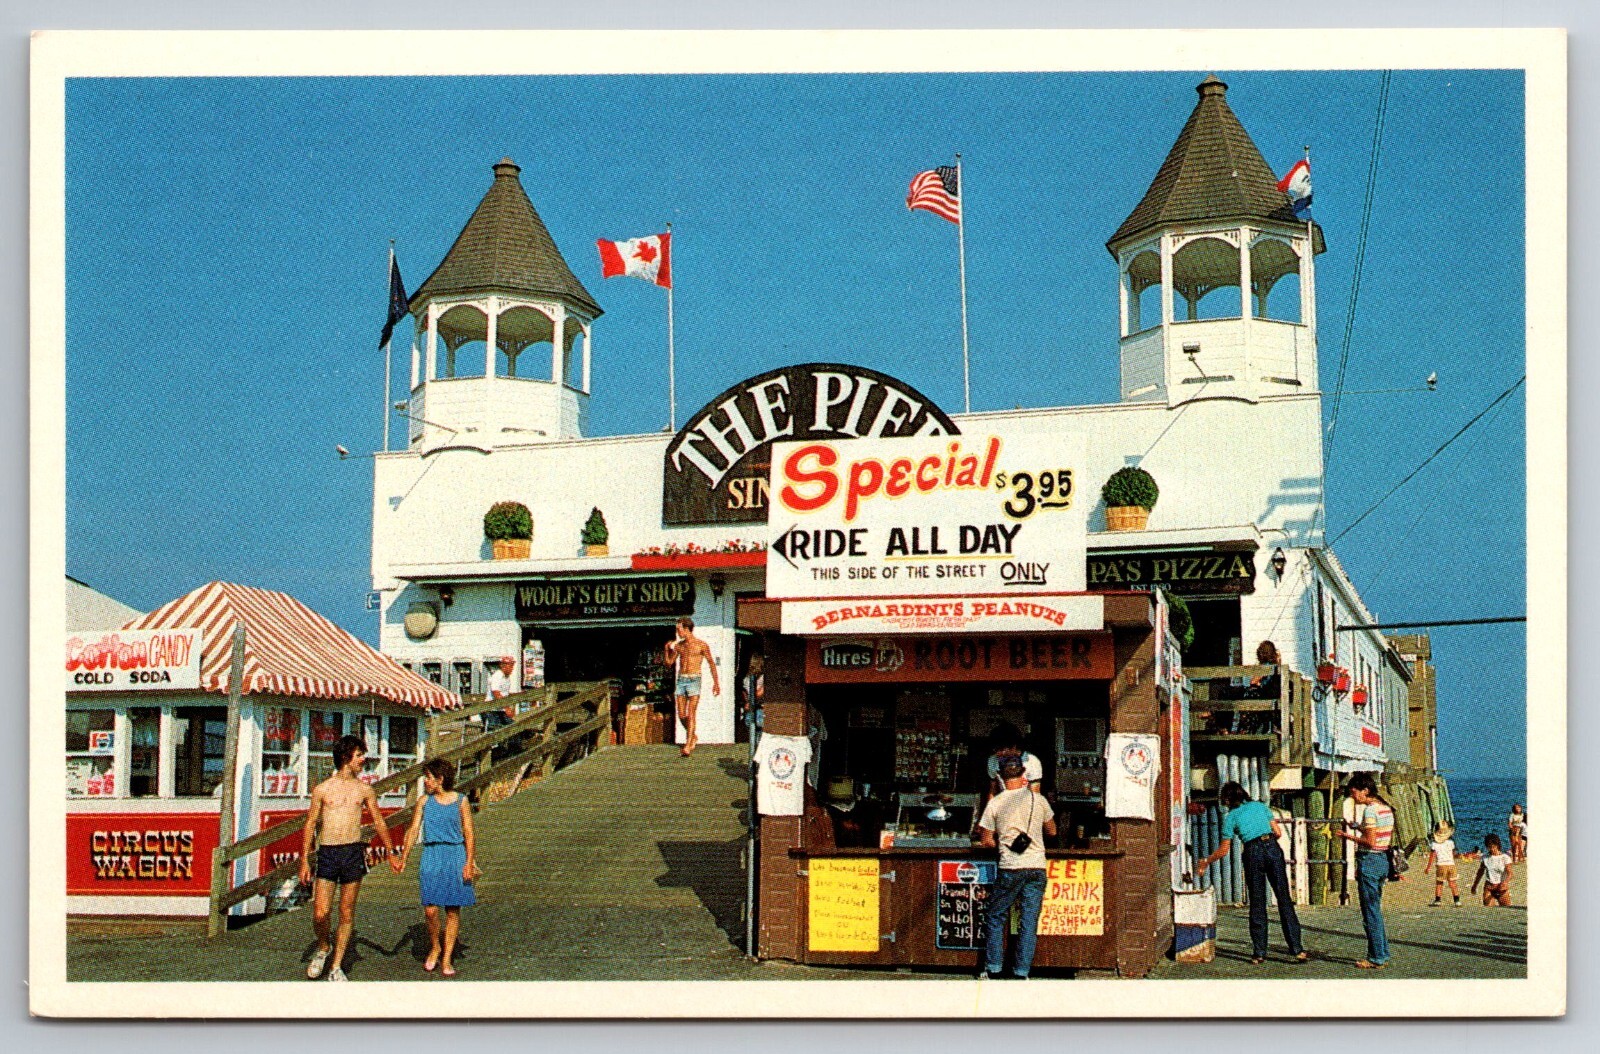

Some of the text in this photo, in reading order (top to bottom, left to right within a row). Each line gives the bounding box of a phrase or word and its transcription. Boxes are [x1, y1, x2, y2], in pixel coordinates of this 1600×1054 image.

[671, 374, 794, 490] THE
[780, 437, 1000, 521] Special
[727, 477, 770, 509] SIN
[790, 524, 1022, 559] RIDE ALL DAY
[811, 561, 1050, 582] THIS SIDE OF THE STREET ONLY
[1152, 554, 1250, 581] PIZZA
[519, 581, 690, 607] WOOLF'S GIFT SHOP
[811, 602, 1068, 630] BERNARDINI'S PEANUTS
[148, 633, 194, 668] CANDY
[823, 650, 871, 667] Hires
[914, 636, 1092, 671] ROOT BEER
[74, 670, 171, 684] COLD SODA
[92, 830, 194, 853] CIRCUS
[92, 855, 194, 878] WAGON
[1047, 859, 1088, 879] EE!
[1052, 881, 1100, 902] DRINK
[1041, 914, 1102, 927] CASHEW OR
